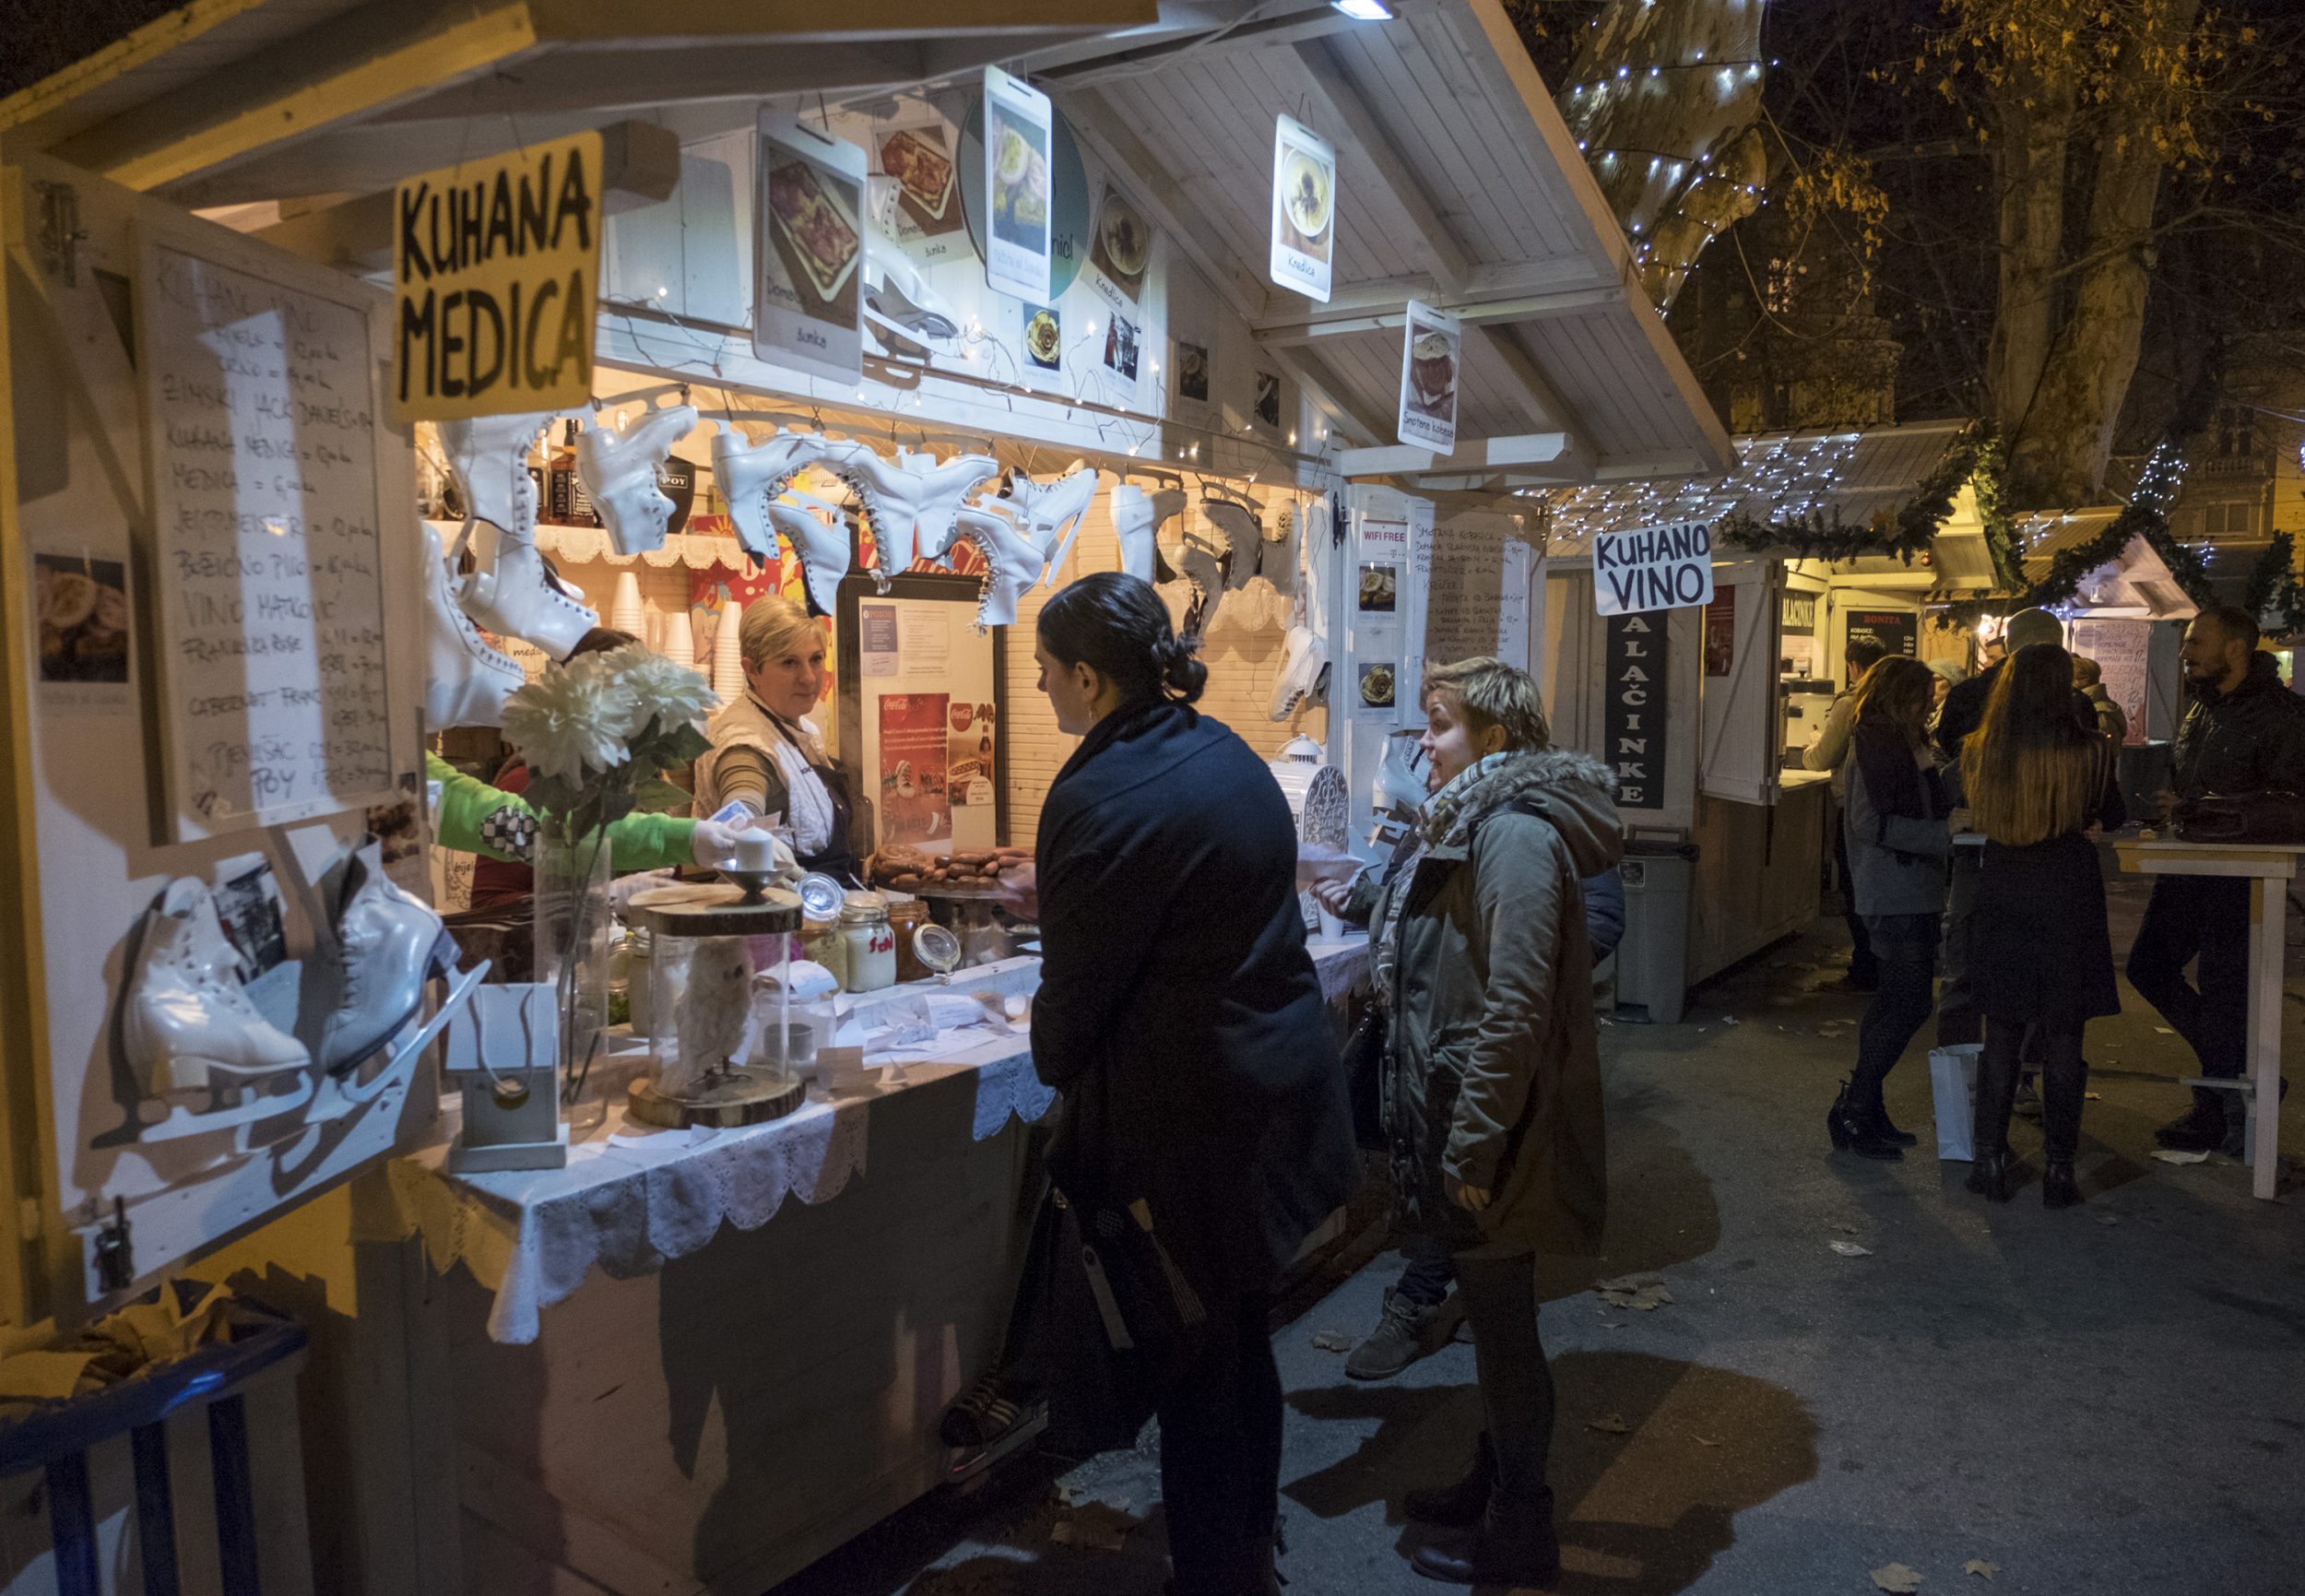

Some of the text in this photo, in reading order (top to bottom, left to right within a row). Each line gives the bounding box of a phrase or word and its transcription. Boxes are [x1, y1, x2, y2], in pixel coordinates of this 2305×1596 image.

[401, 147, 591, 283] KUHANA
[1051, 235, 1073, 260] nicl
[399, 269, 590, 402] MEDICA
[661, 477, 687, 487] POY
[1364, 531, 1406, 542] WIFI FREE
[1597, 525, 1711, 570] KUHANO
[1608, 562, 1705, 611] VINO
[1863, 615, 1901, 624] BONITA
[883, 698, 908, 711] Coca-Cola
[951, 708, 972, 720] Coca-Cola
[1619, 616, 1651, 803] ALAČINKE
